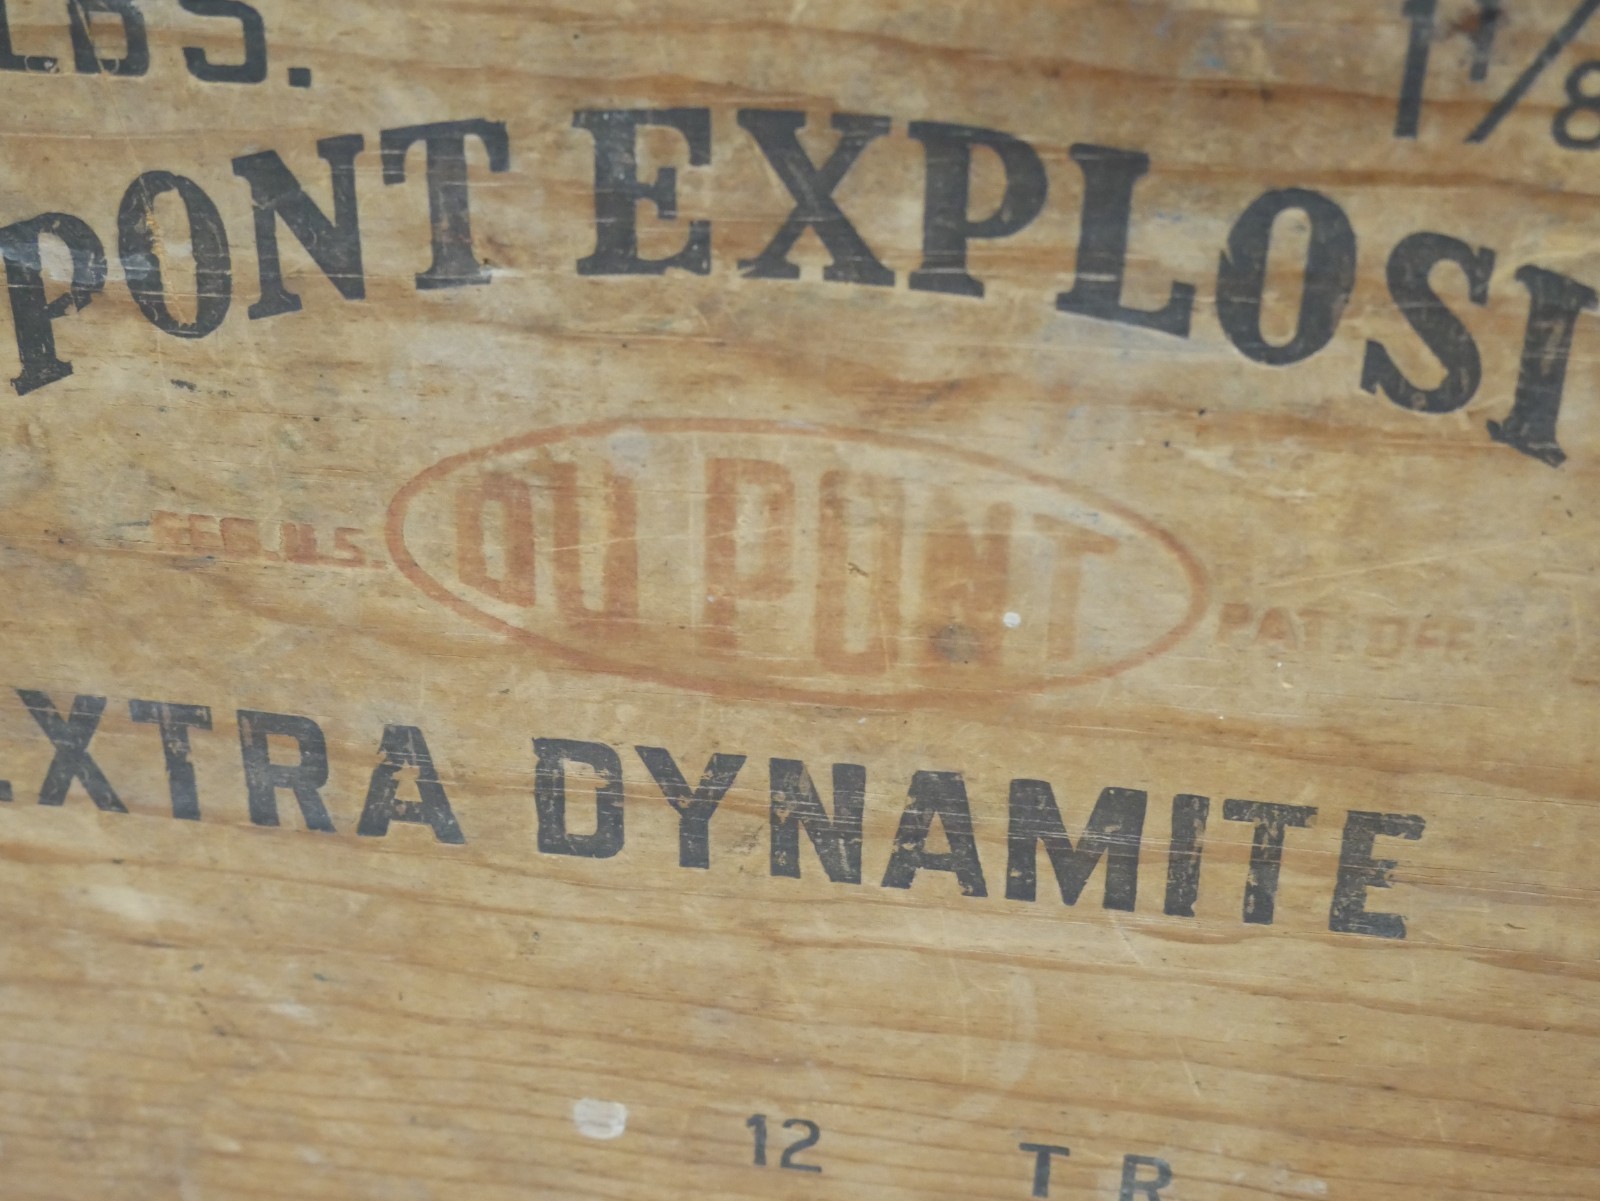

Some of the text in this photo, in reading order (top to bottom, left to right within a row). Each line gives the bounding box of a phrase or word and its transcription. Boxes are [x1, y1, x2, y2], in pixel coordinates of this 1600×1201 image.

[0, 106, 1599, 468] PONT EXPLOSI
[0, 688, 1427, 940] XTRA DYNAMITE
[746, 1113, 823, 1174] 12
